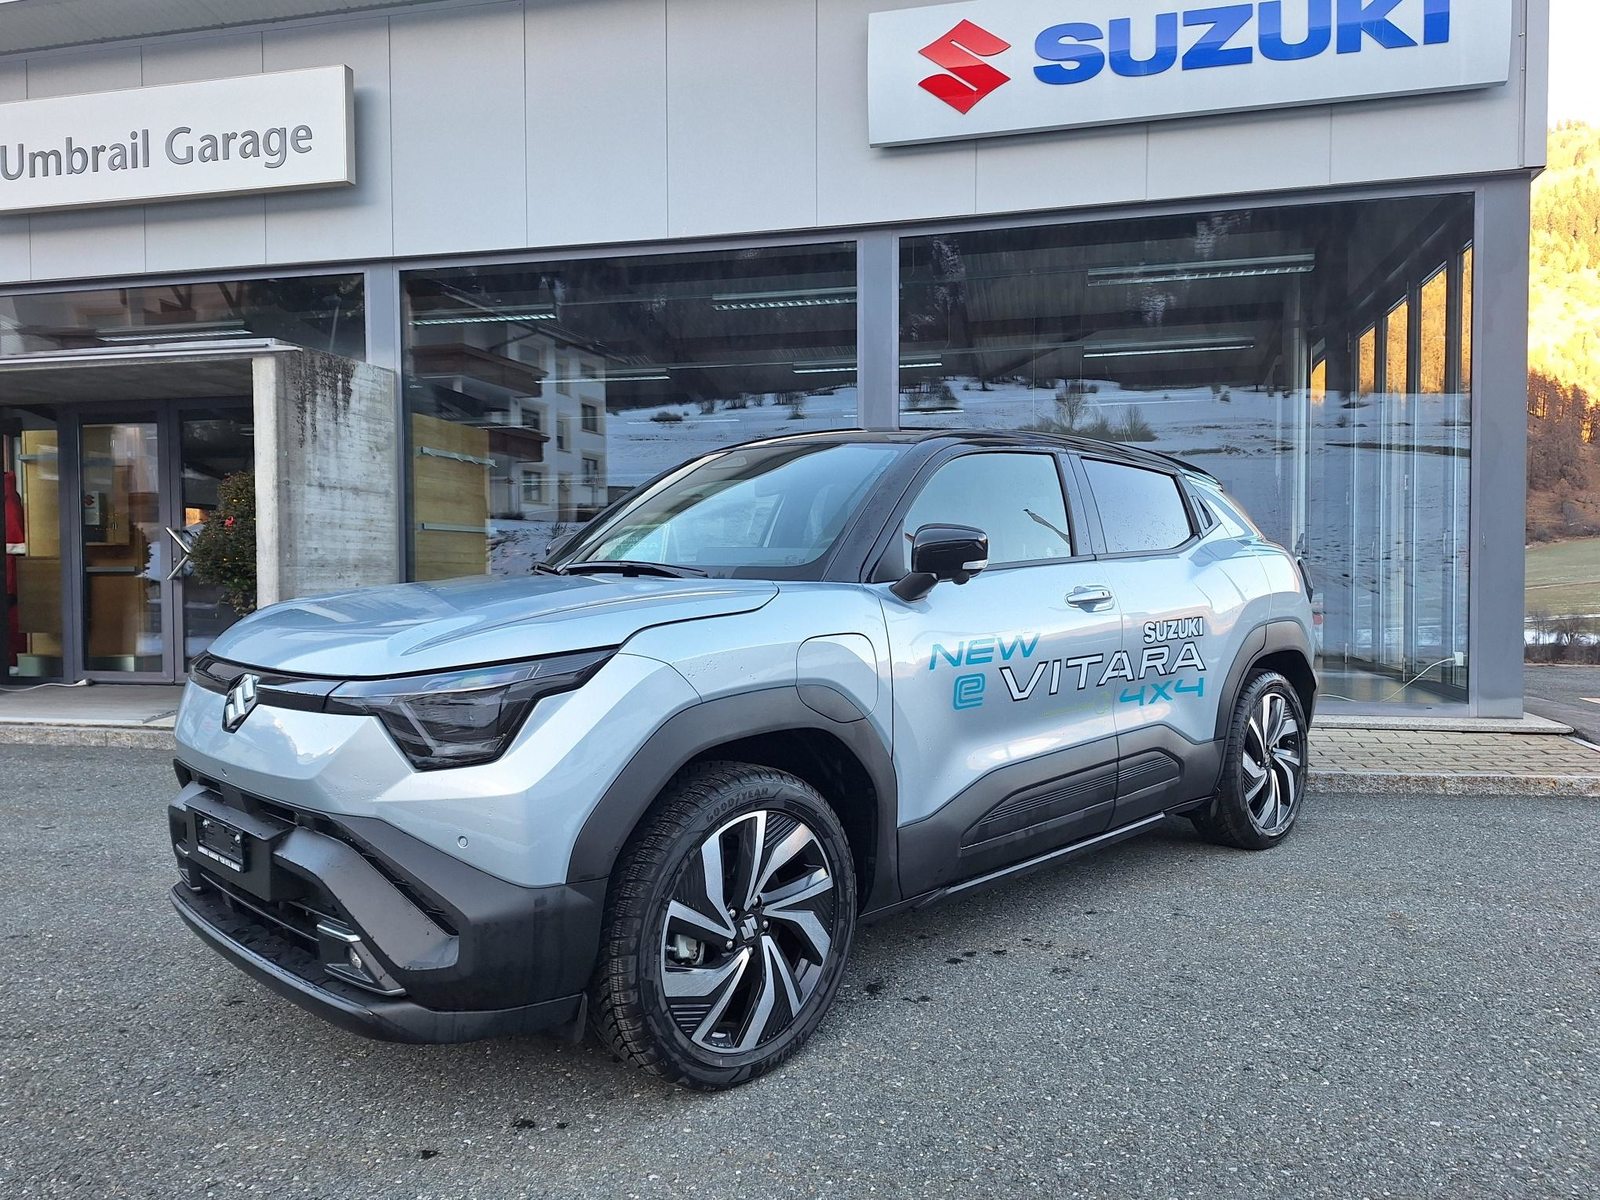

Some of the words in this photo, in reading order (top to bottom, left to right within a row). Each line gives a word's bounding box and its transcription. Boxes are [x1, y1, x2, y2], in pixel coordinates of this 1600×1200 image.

[1033, 0, 1450, 85] SUZUKI
[0, 129, 150, 181] Umbrail
[164, 124, 313, 169] Garage
[929, 633, 1041, 670] NEW
[1143, 616, 1204, 644] SUZUKI
[999, 642, 1207, 702] VITARA
